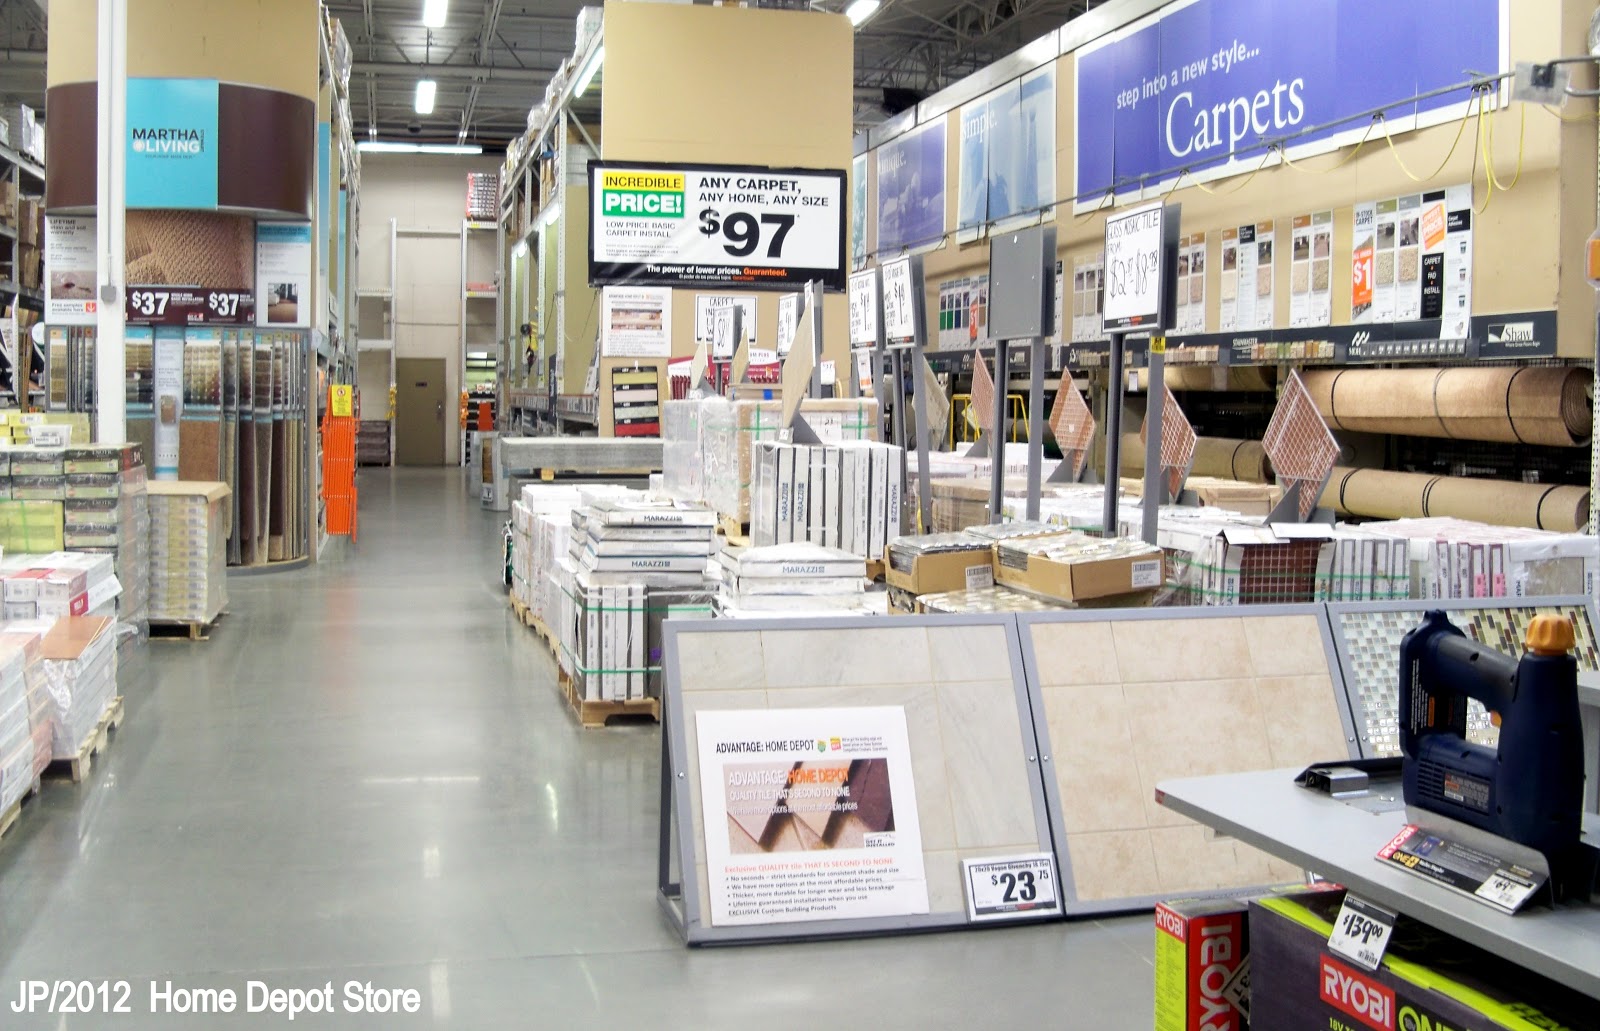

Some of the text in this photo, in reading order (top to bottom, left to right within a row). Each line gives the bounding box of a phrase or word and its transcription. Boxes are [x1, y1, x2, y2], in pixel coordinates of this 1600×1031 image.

[1117, 40, 1260, 109] step into a new style...
[1166, 77, 1305, 161] Carpets
[133, 128, 199, 140] MARTHA
[146, 140, 200, 153] LIVING
[605, 176, 681, 190] INCREDIBLE
[699, 178, 802, 195] ANY CARPET,
[605, 193, 682, 214] PRICE!
[699, 193, 829, 207] ANY HOME, ANY SIZE
[1107, 222, 1123, 240] GLASS
[1142, 212, 1159, 232] TILE
[1356, 217, 1373, 226] CARPET
[1107, 243, 1121, 255] FROM
[1424, 255, 1441, 265] CARPET
[647, 264, 788, 277] The power of lower prices. Guaranteed.
[1354, 258, 1372, 291] $1
[1424, 286, 1440, 294] INSTALL
[132, 291, 169, 316] $37
[209, 291, 239, 316] $37
[1505, 326, 1532, 341] Shaw
[782, 565, 818, 574] MARAZZI
[716, 740, 814, 754] ADVANTAGE: HOME DEPOT
[729, 767, 849, 786] ADVANTAGE: HOME DEPOT
[730, 790, 757, 801] QUALITY
[760, 789, 772, 800] TILE
[794, 788, 820, 799] SECOND
[821, 787, 830, 798] TO
[831, 786, 850, 797] NONE
[842, 802, 858, 813] prices
[1381, 826, 1416, 857] RYOBI
[759, 864, 789, 872] QUALITY
[832, 860, 860, 868] SECOND
[873, 858, 893, 866] NONE
[759, 898, 792, 906] guaranteed
[729, 908, 759, 916] EXCLUSIVE
[786, 905, 809, 913] Building
[1156, 906, 1184, 938] RYOBI
[1324, 964, 1391, 1028] RYOBI
